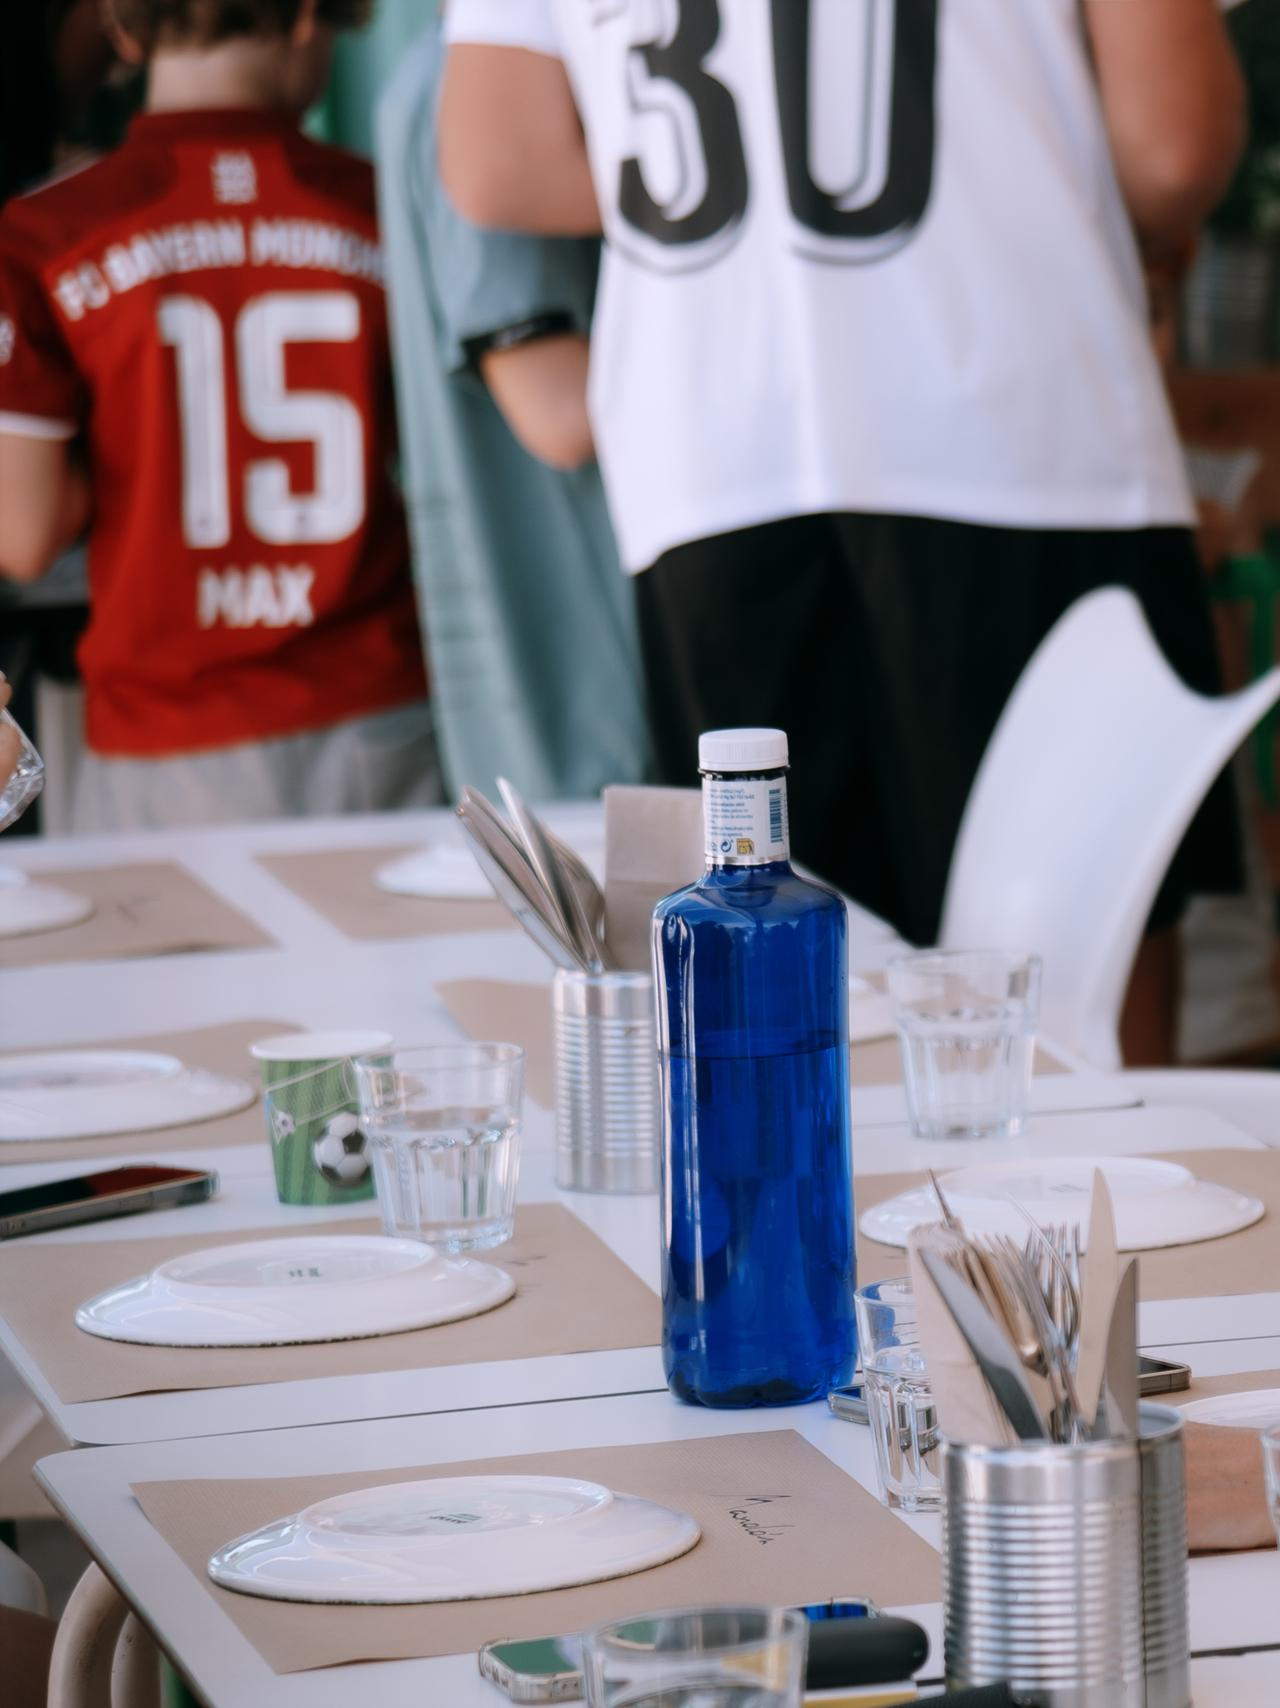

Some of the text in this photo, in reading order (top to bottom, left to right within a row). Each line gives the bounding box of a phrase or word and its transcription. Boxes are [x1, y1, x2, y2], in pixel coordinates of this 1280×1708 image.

[55, 260, 110, 321] FC
[104, 217, 246, 293] BAYERN
[157, 292, 365, 548] 15
[198, 567, 314, 629] MAX
